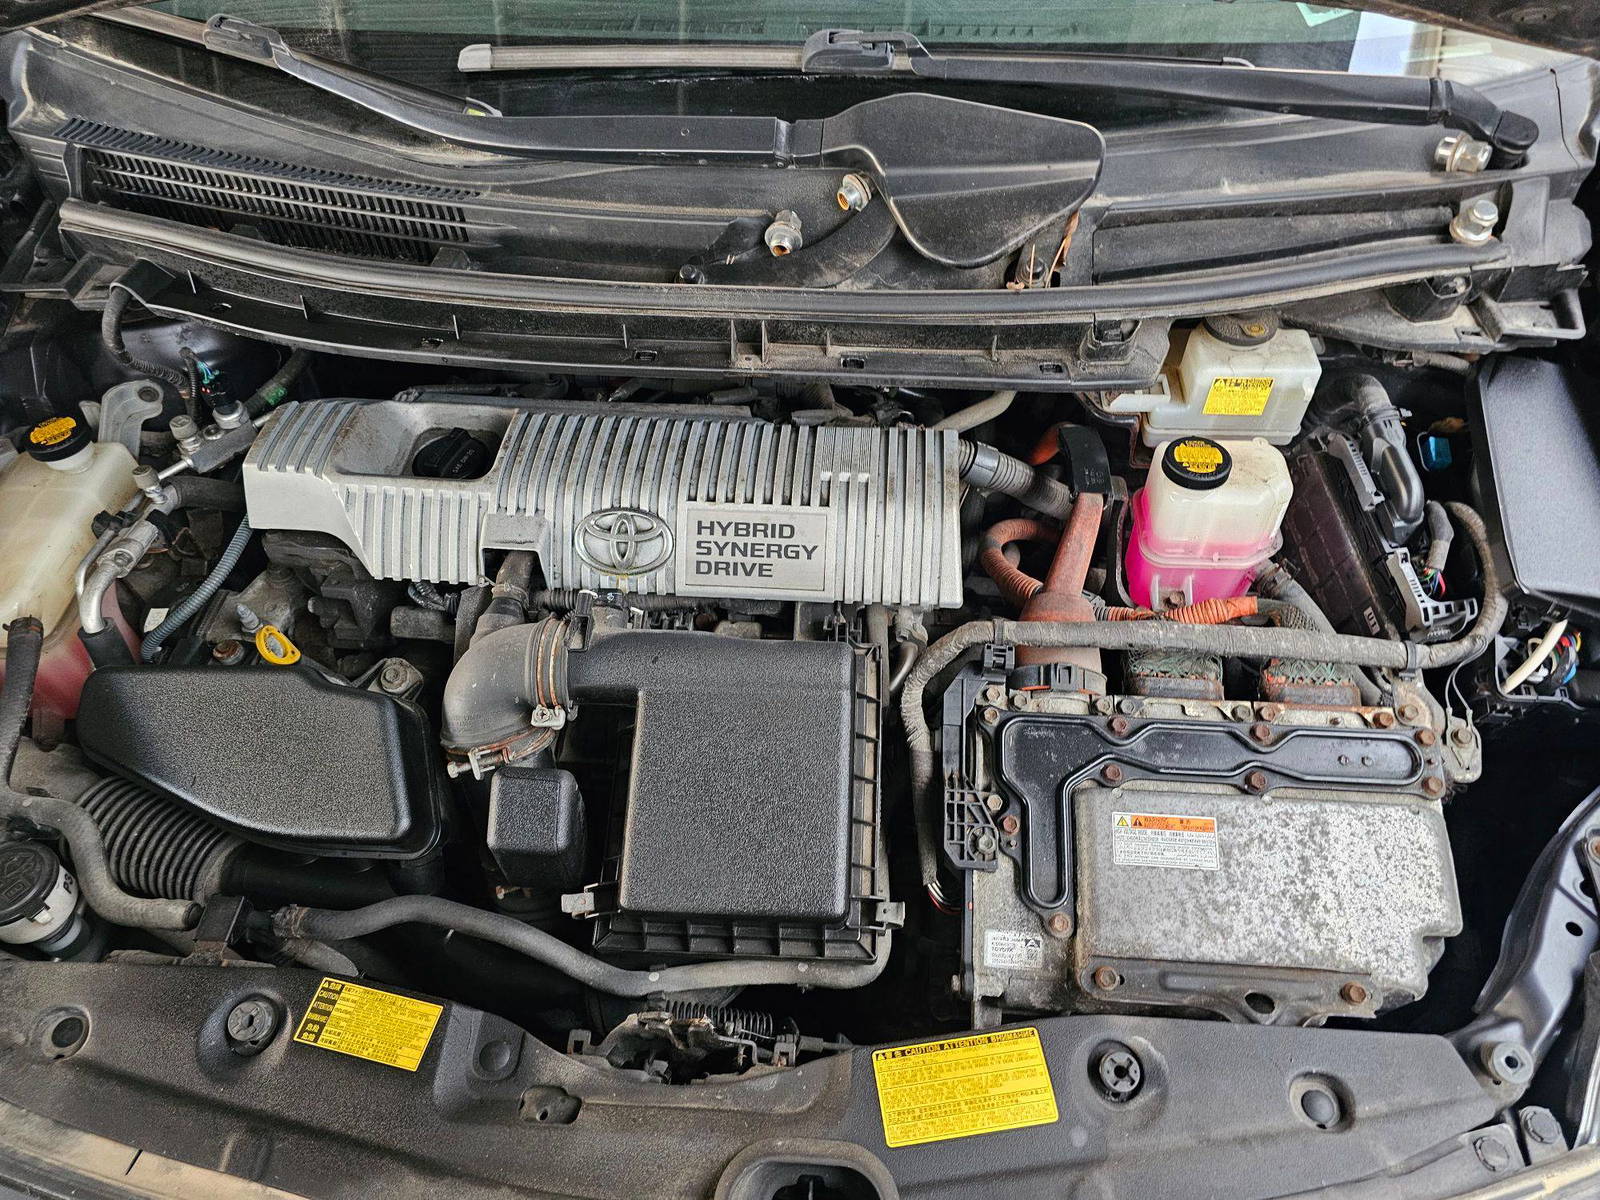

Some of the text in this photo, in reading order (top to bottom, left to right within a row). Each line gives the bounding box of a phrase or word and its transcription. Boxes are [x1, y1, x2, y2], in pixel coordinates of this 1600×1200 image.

[696, 520, 795, 539] HYBRID
[695, 540, 819, 560] SYNERGY
[695, 560, 774, 578] DRIVE
[904, 1043, 940, 1056] CAUTION
[943, 1036, 987, 1051] ATTENTION
